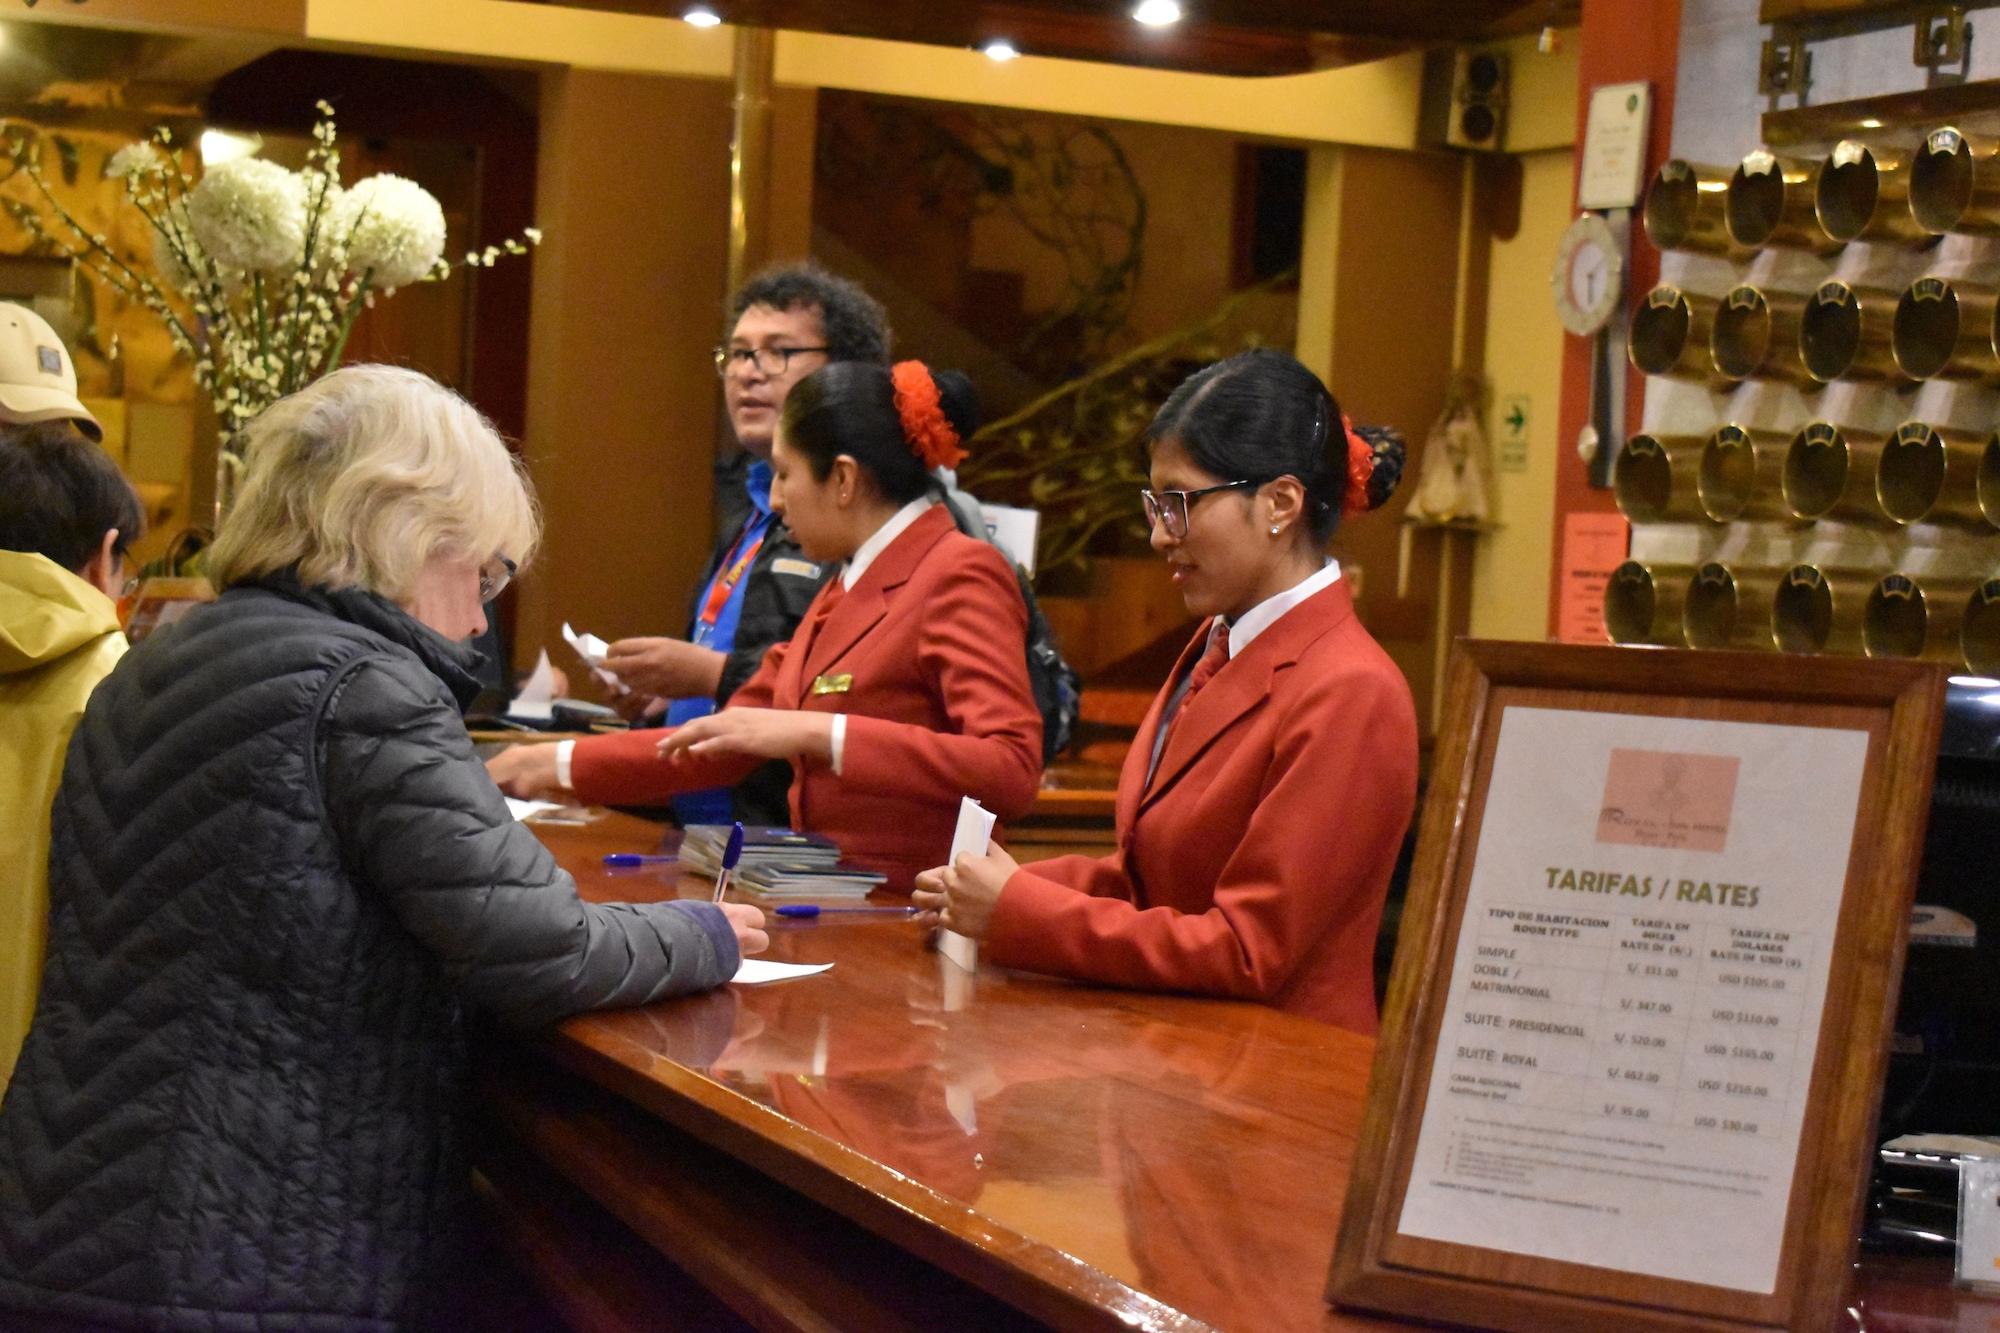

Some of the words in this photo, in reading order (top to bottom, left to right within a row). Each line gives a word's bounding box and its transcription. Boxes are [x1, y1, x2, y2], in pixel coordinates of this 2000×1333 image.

[1546, 867, 1653, 897] TARIFAS
[1658, 878, 1670, 900] /
[1677, 879, 1760, 908] RATES
[1488, 908, 1514, 920] TIPO
[1518, 910, 1533, 921] DE
[1536, 912, 1610, 929] HABITACION
[1512, 924, 1546, 936] ROOM
[1550, 927, 1580, 939] TYPE
[1477, 946, 1517, 960] SIMPLE
[1473, 963, 1509, 978] DOBLE
[1719, 974, 1741, 985] USD
[1469, 980, 1550, 999] MATRIMONIAL
[1712, 1009, 1734, 1022] USD
[1464, 1012, 1502, 1027] SUITE
[1508, 1018, 1586, 1038] PRESIDENCIAL
[1456, 1046, 1495, 1062] SUITE
[1502, 1052, 1539, 1068] ROYAL
[1704, 1044, 1727, 1056] USD
[1698, 1080, 1721, 1091] USD
[1694, 1116, 1717, 1128] USD
